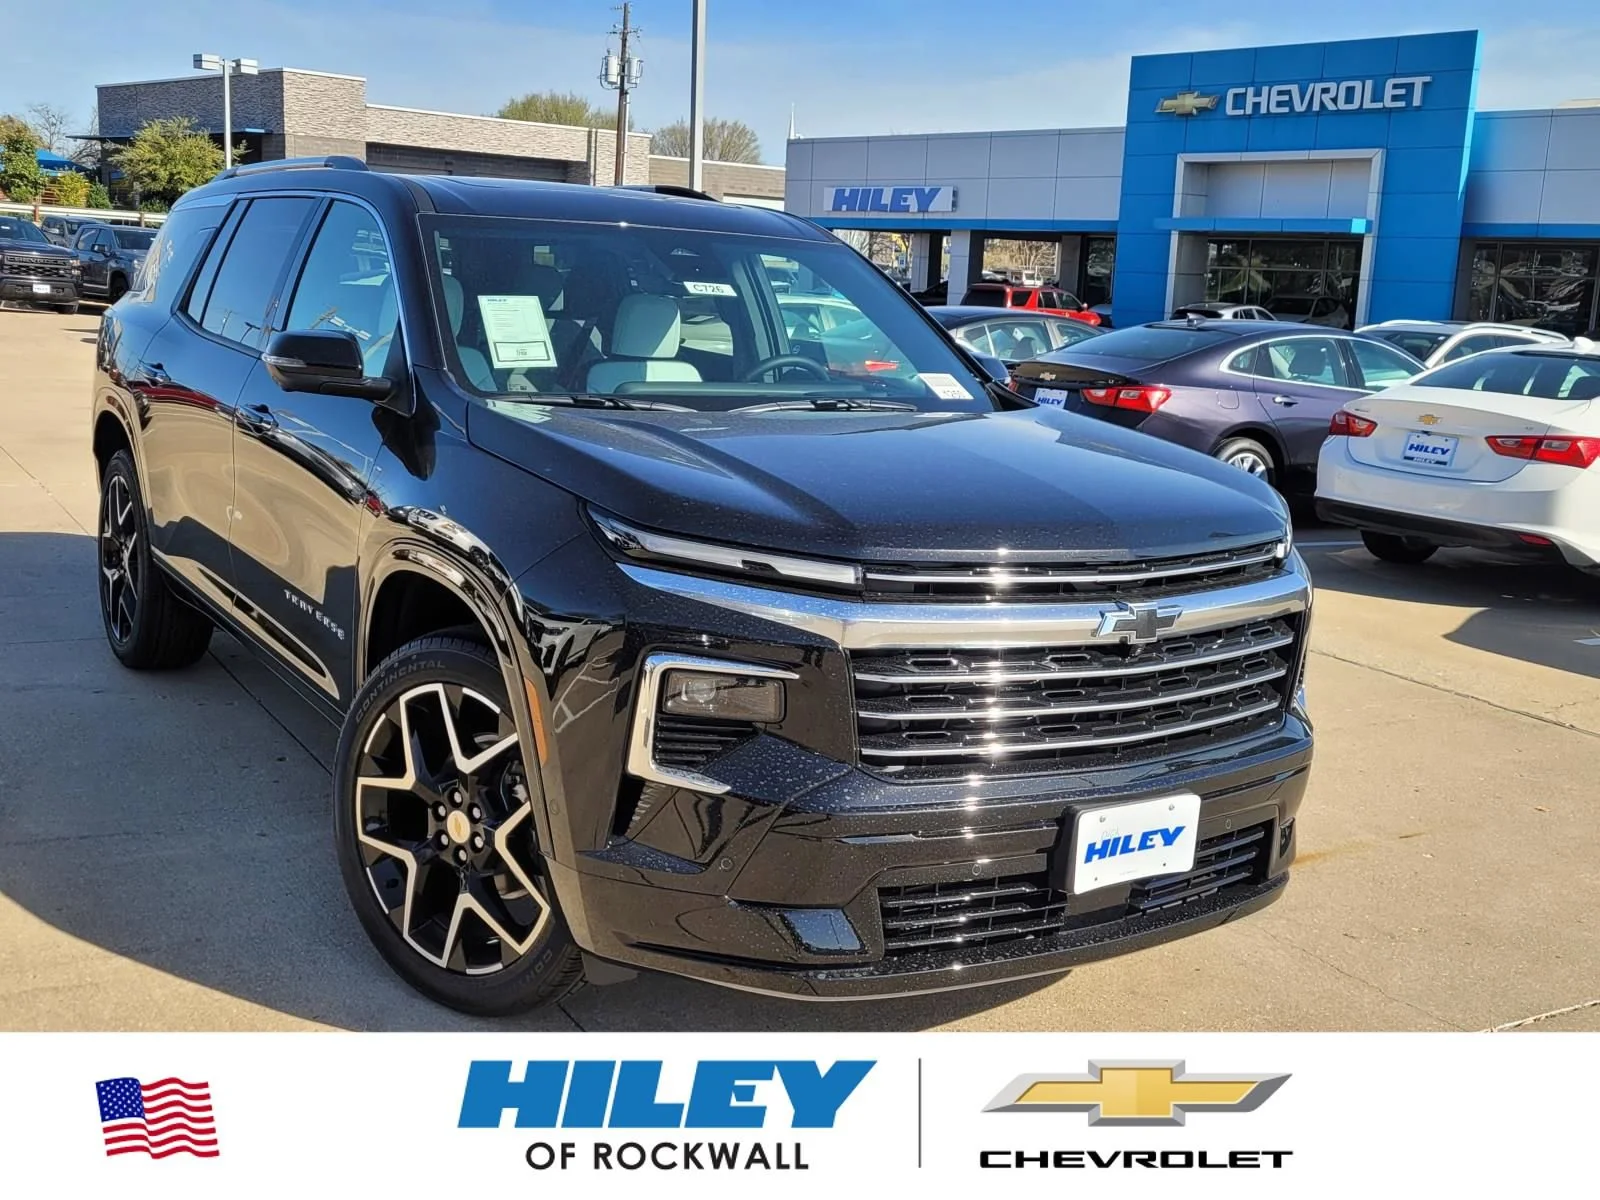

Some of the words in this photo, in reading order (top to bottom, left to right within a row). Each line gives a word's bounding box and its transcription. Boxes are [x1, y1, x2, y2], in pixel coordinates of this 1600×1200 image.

[1225, 76, 1433, 116] CHEVROLET
[831, 187, 942, 213] HILEY
[693, 284, 725, 294] C726
[1037, 397, 1064, 405] HILEY
[1408, 443, 1451, 456] HILEY
[284, 589, 345, 641] TRAVERSE
[356, 660, 446, 723] CONTINENTAL
[1083, 825, 1186, 864] HILEY
